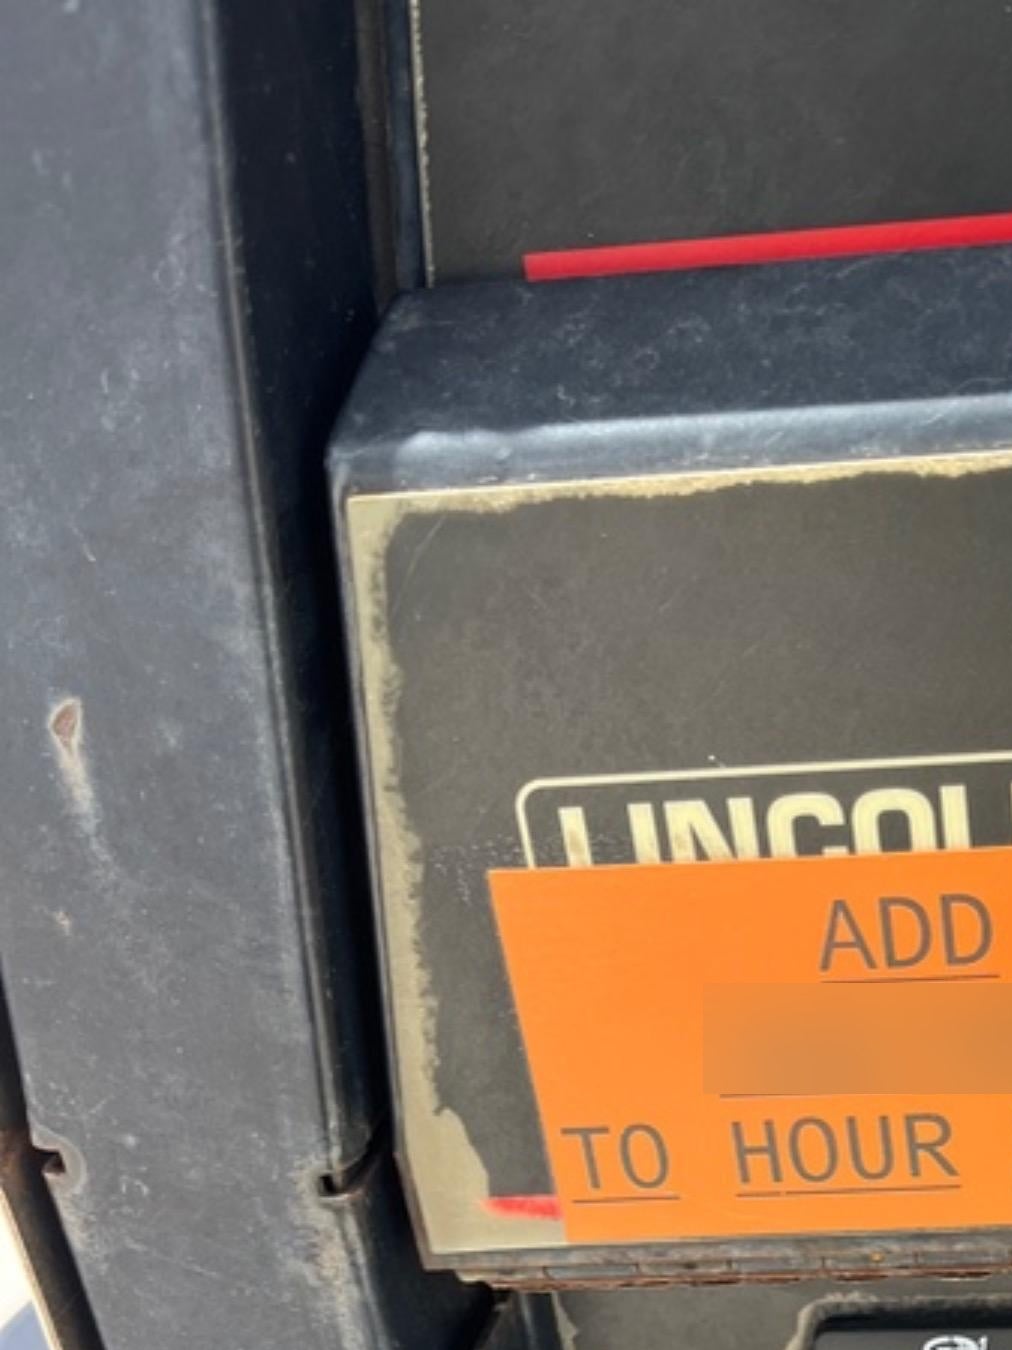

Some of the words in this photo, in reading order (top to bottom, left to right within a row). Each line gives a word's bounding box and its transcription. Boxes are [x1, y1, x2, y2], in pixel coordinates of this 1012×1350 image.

[819, 892, 994, 972] ADD
[561, 1123, 670, 1190] TO
[731, 1112, 959, 1185] HOUR
